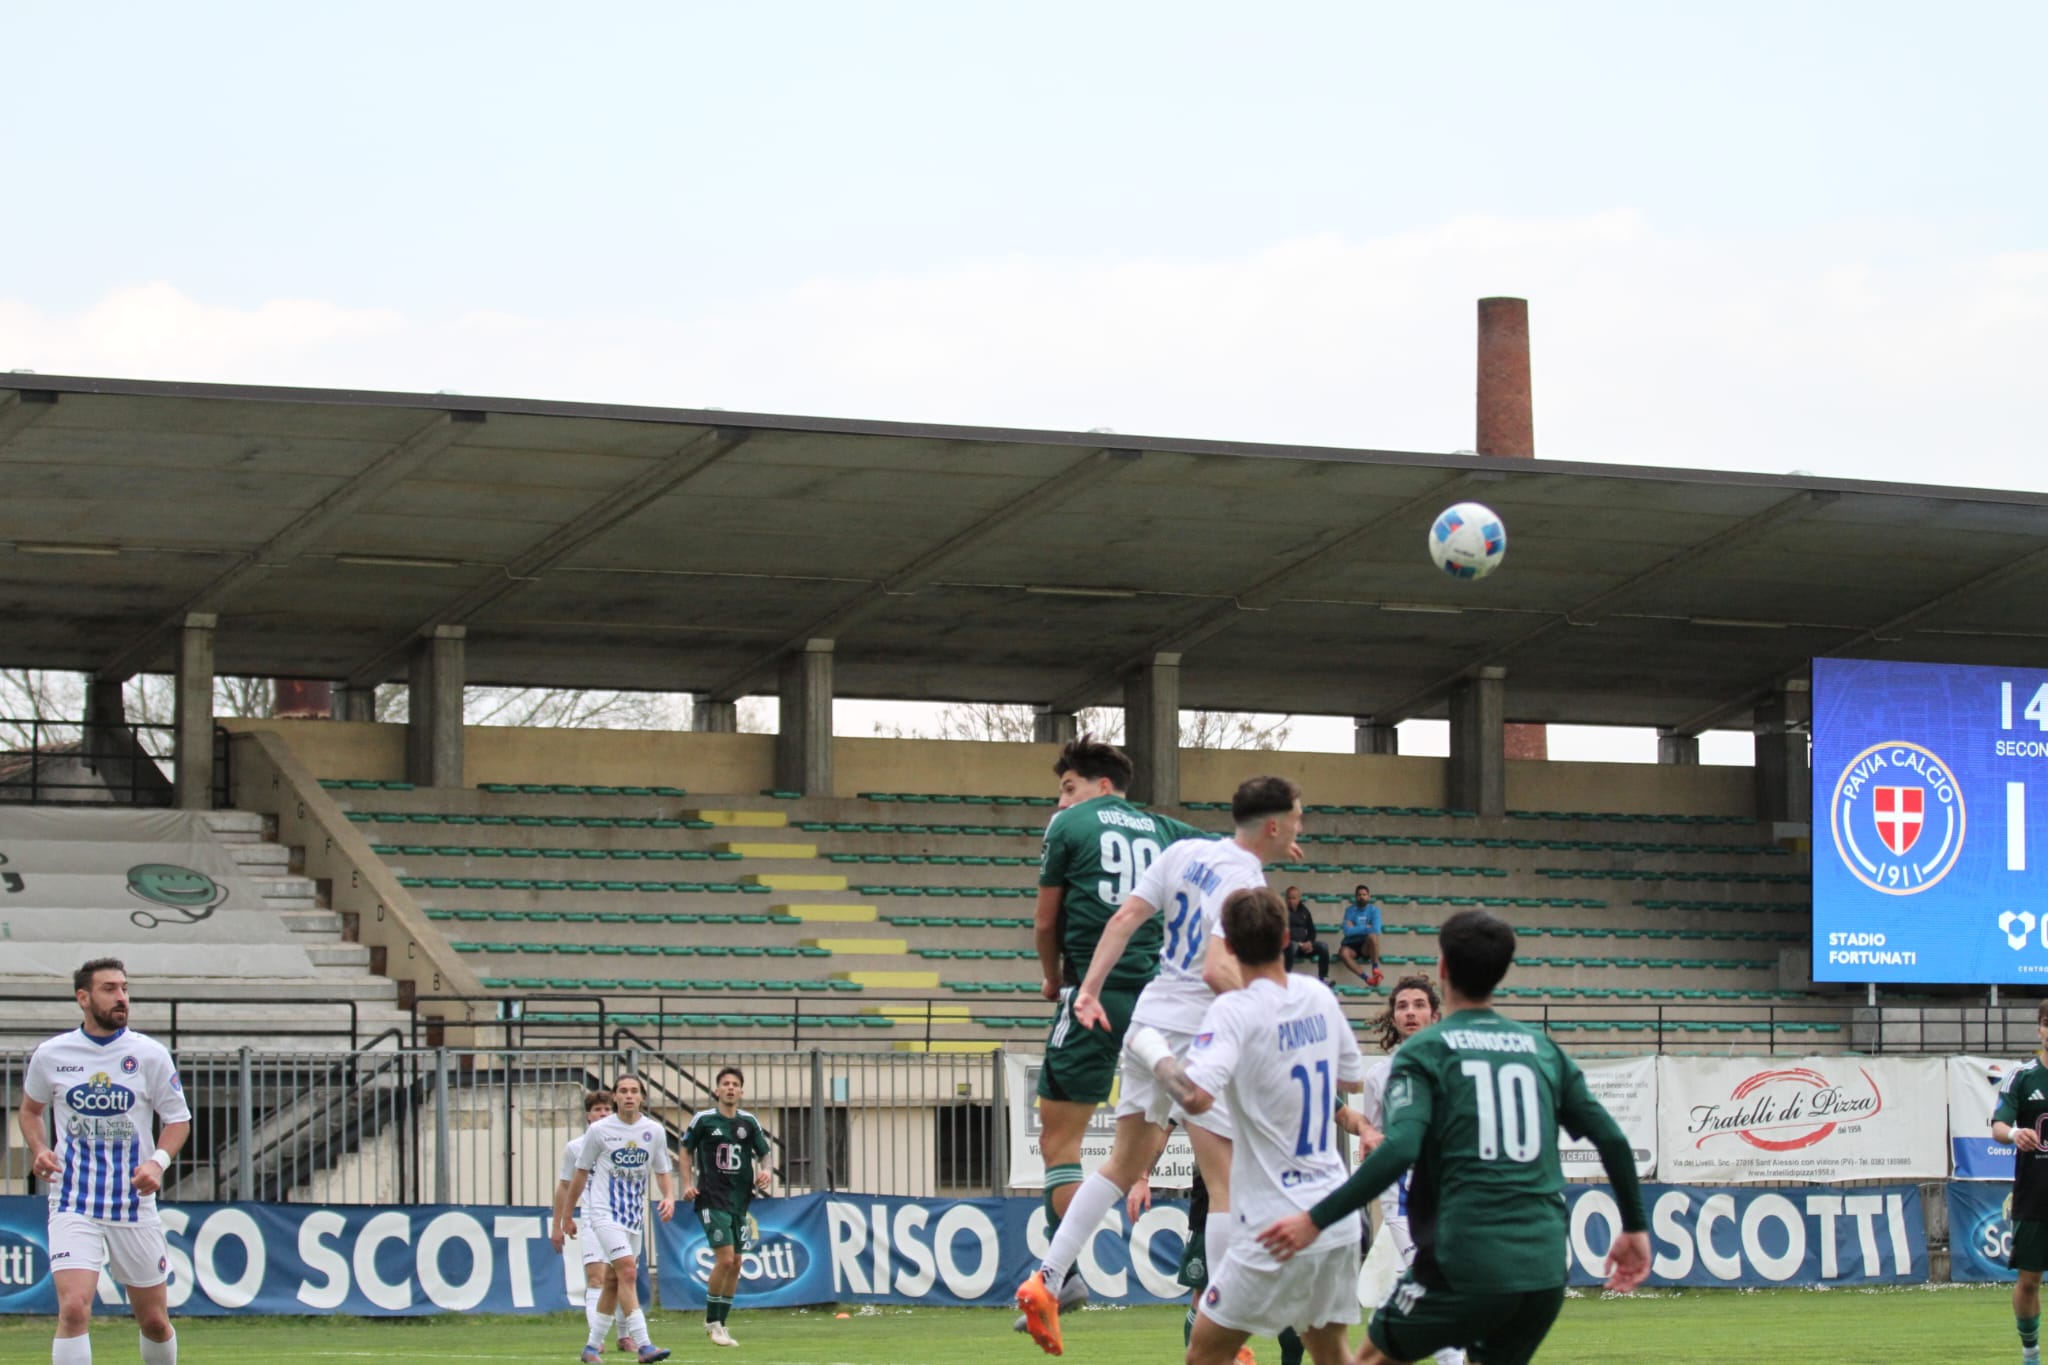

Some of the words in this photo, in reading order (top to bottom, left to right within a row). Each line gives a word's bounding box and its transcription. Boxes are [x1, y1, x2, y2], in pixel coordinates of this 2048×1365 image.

[1842, 752, 1887, 800] PAVIA
[1891, 749, 1953, 804] CALCIO
[1098, 830, 1161, 906] 90
[1876, 862, 1924, 888] 1911
[1166, 891, 1204, 971] 39
[1829, 932, 1886, 947] STADIO
[1829, 951, 1916, 966] FORTUNATI
[1441, 1029, 1539, 1054] VERNOCCHI
[72, 1089, 129, 1112] Scotti
[1290, 1059, 1330, 1157] 21
[1461, 1059, 1542, 1163] 10
[1688, 1096, 1776, 1133] Fratelli
[1779, 1091, 1803, 1120] di
[1808, 1086, 1876, 1117] Pizza
[615, 1152, 648, 1165] Scotti
[1987, 1146, 2011, 1157] Corso
[826, 1200, 999, 1300] RISO
[1652, 1191, 1912, 1281] SCOTTI
[296, 1210, 586, 1311] SCOTT
[695, 1242, 797, 1281] Sotti
